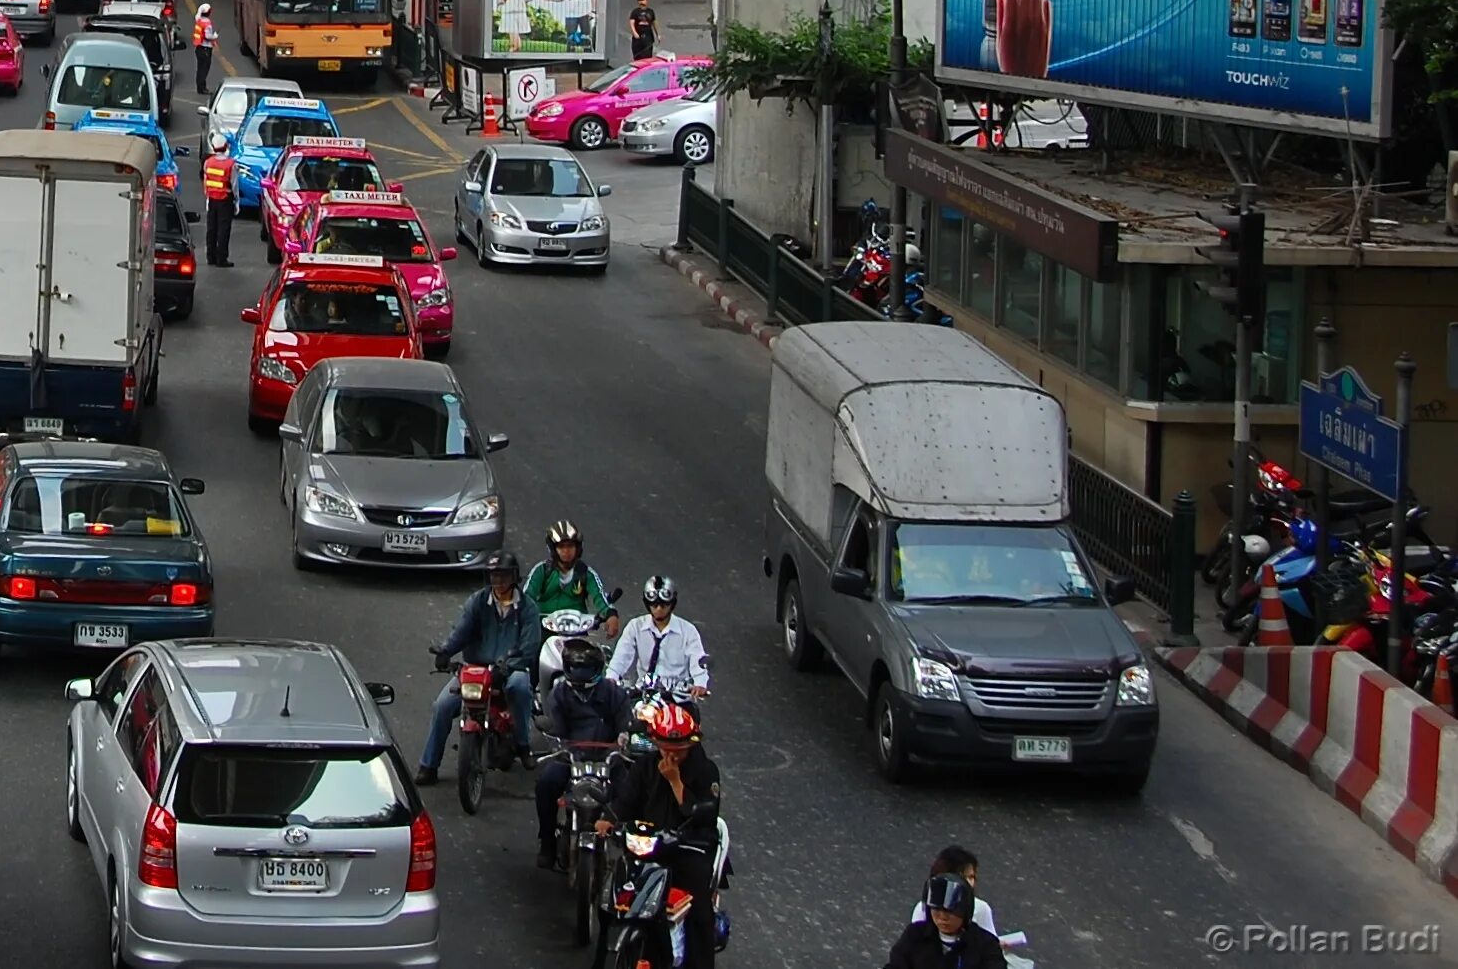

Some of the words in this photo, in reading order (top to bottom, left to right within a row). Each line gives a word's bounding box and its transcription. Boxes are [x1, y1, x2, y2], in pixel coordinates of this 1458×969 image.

[1319, 406, 1375, 459] เฉลิมเผ่า
[403, 533, 426, 546] 5725
[98, 626, 124, 638] 3533
[1038, 740, 1068, 752] 5779
[289, 862, 325, 877] 8400
